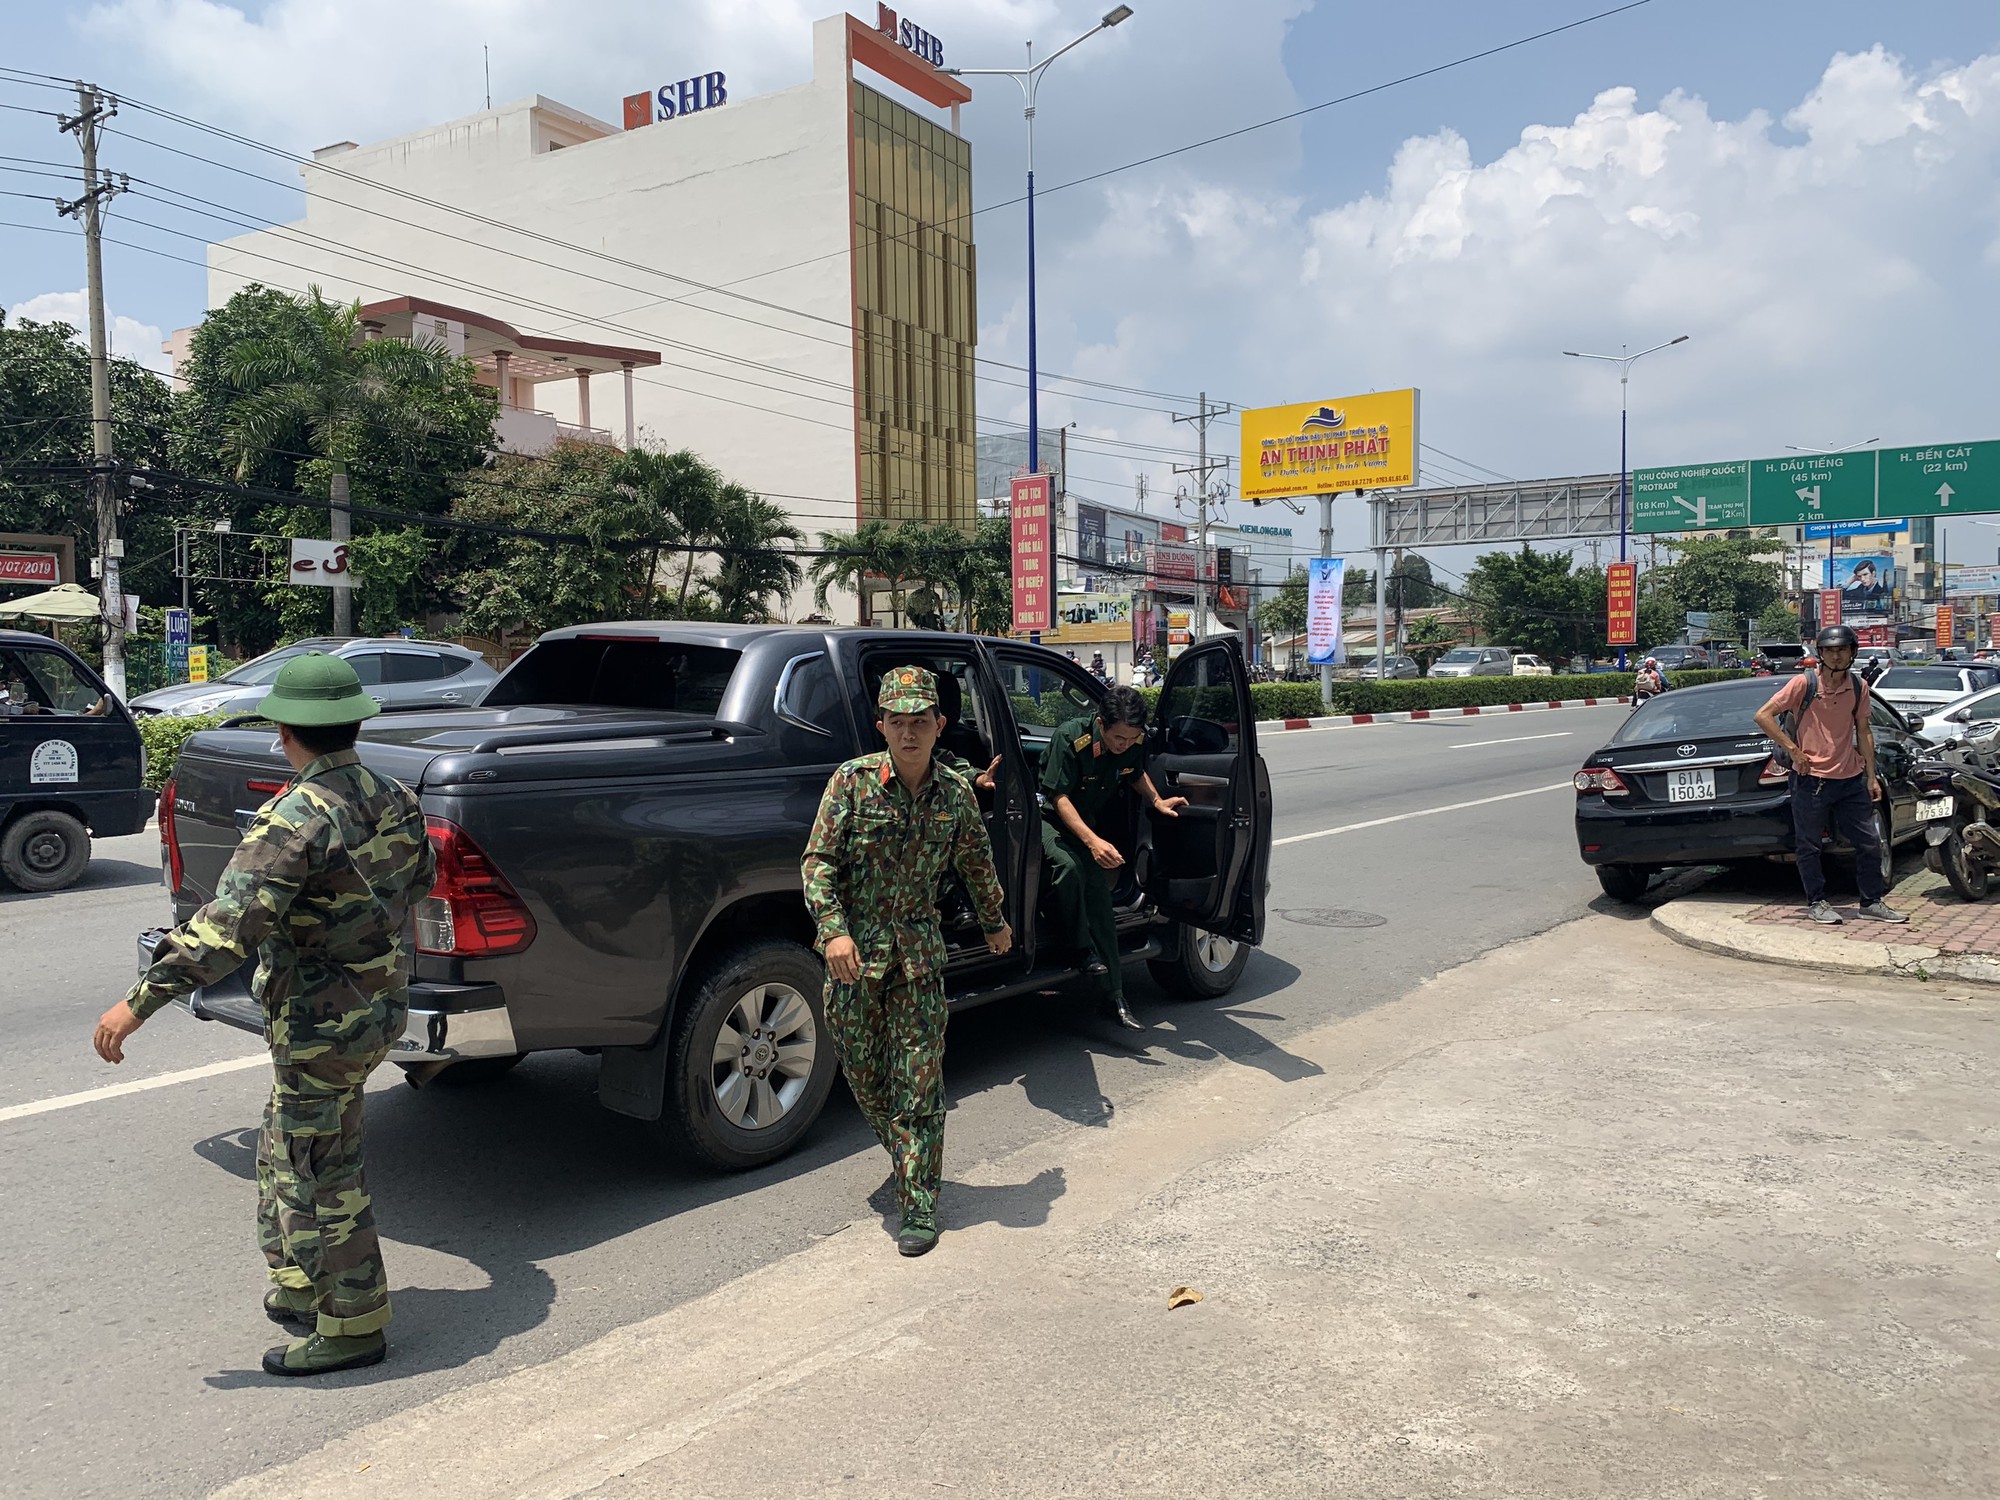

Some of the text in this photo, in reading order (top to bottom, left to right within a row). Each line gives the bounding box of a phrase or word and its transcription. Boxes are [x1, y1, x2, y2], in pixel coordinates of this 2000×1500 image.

[900, 18, 944, 67] SHB
[657, 71, 727, 122] SHB
[1260, 435, 1389, 465] AN THỊNH PHÁT
[1900, 447, 1972, 462] H. BẾN CÁT
[1766, 464, 1777, 472] H.
[1808, 456, 1844, 469] TIẾNG
[1923, 461, 1968, 475] (22 km)
[1638, 462, 1746, 481] KHU CÔNG NGHIỆP QUỐC TẾ
[1791, 471, 1831, 484] (45 km)
[1638, 482, 1678, 492] PROTRADE
[1636, 500, 1669, 510] (18 Km)
[1798, 512, 1824, 521] 2 km
[1240, 524, 1292, 537] KIENLONGBANK
[0, 561, 51, 575] /07/2019
[171, 613, 188, 636] LUẬT
[1679, 771, 1703, 785] 61A
[1671, 785, 1714, 800] 150.34
[1920, 807, 1950, 819] 175.92
